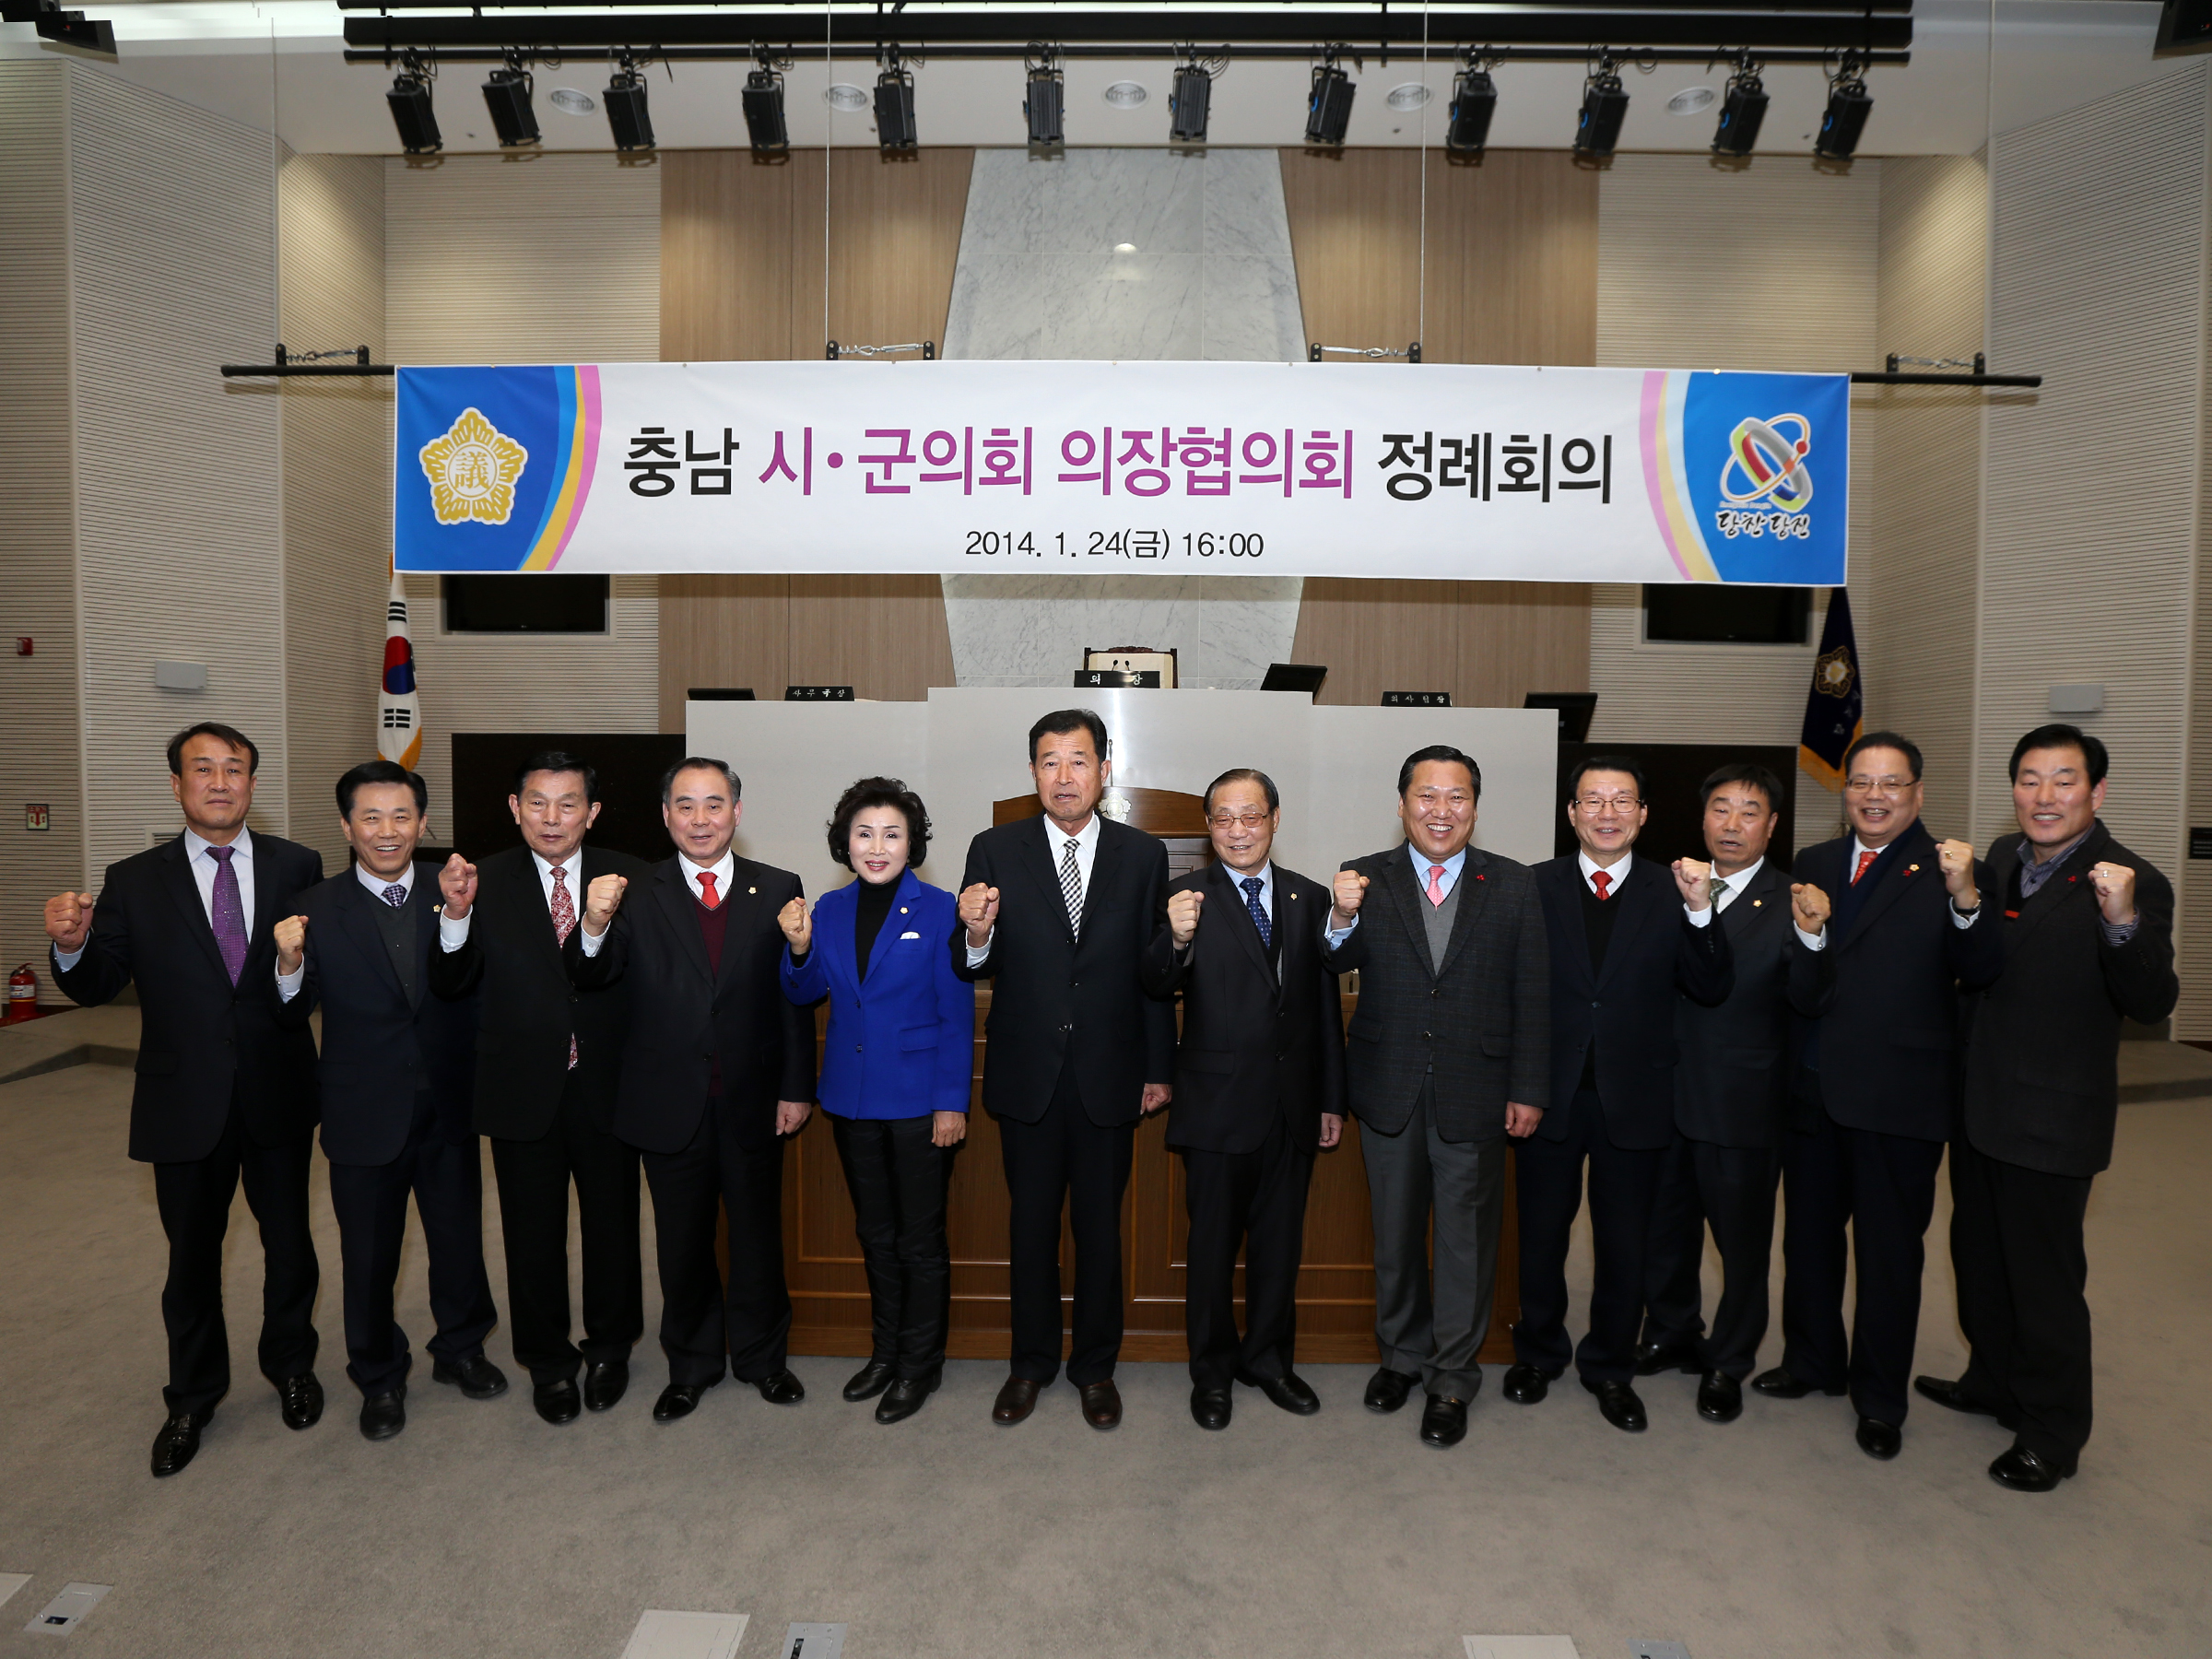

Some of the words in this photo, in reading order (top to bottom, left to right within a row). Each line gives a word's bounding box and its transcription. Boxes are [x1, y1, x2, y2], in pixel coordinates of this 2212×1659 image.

[624, 427, 740, 498] 충남
[1058, 427, 1353, 500] 의장협의회
[1378, 430, 1613, 504] 정례회의
[1770, 513, 1809, 539] 당진
[965, 531, 1041, 558] 2014.
[1055, 532, 1077, 558] 1.
[1088, 528, 1171, 560] 24(금)
[1182, 532, 1265, 558] 16:00
